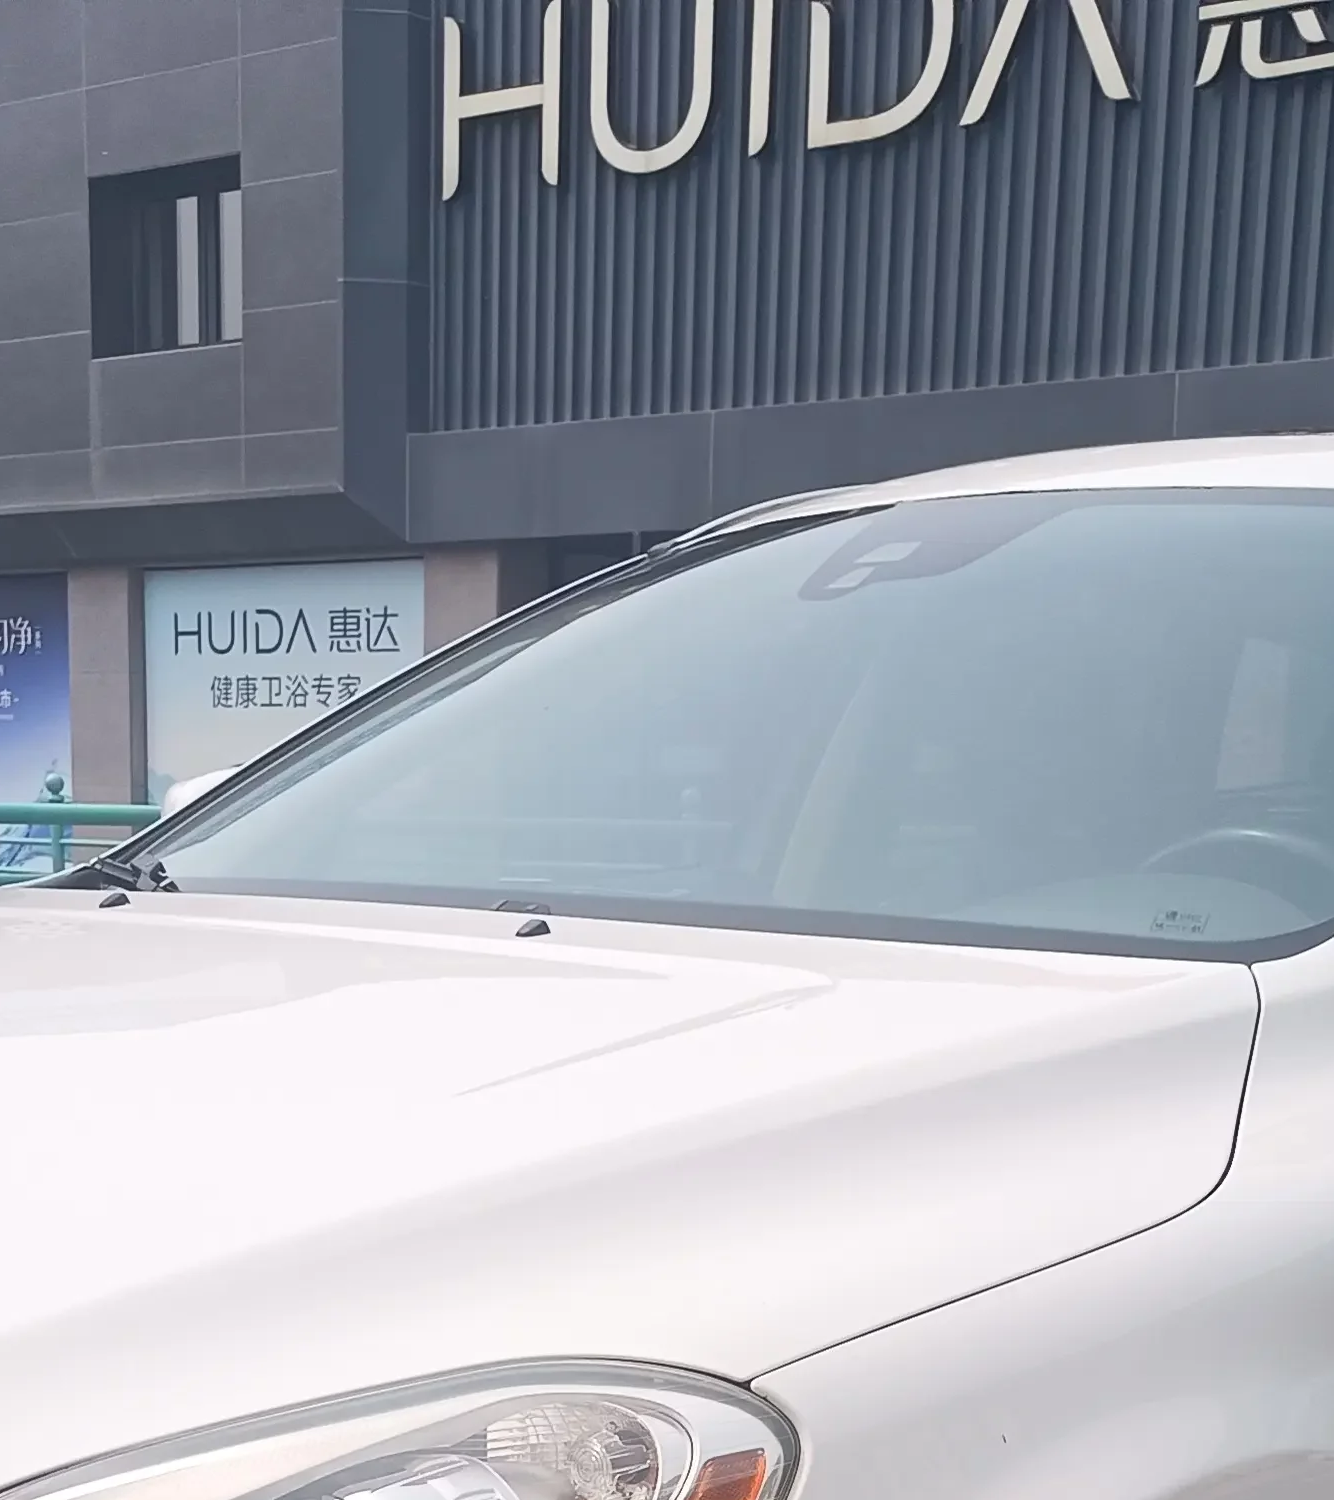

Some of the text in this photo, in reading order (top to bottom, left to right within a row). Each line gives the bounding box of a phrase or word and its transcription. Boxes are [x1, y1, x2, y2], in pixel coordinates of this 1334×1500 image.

[174, 605, 401, 655] HUIDA 惠达
[210, 674, 362, 709] 健康卫浴专家
